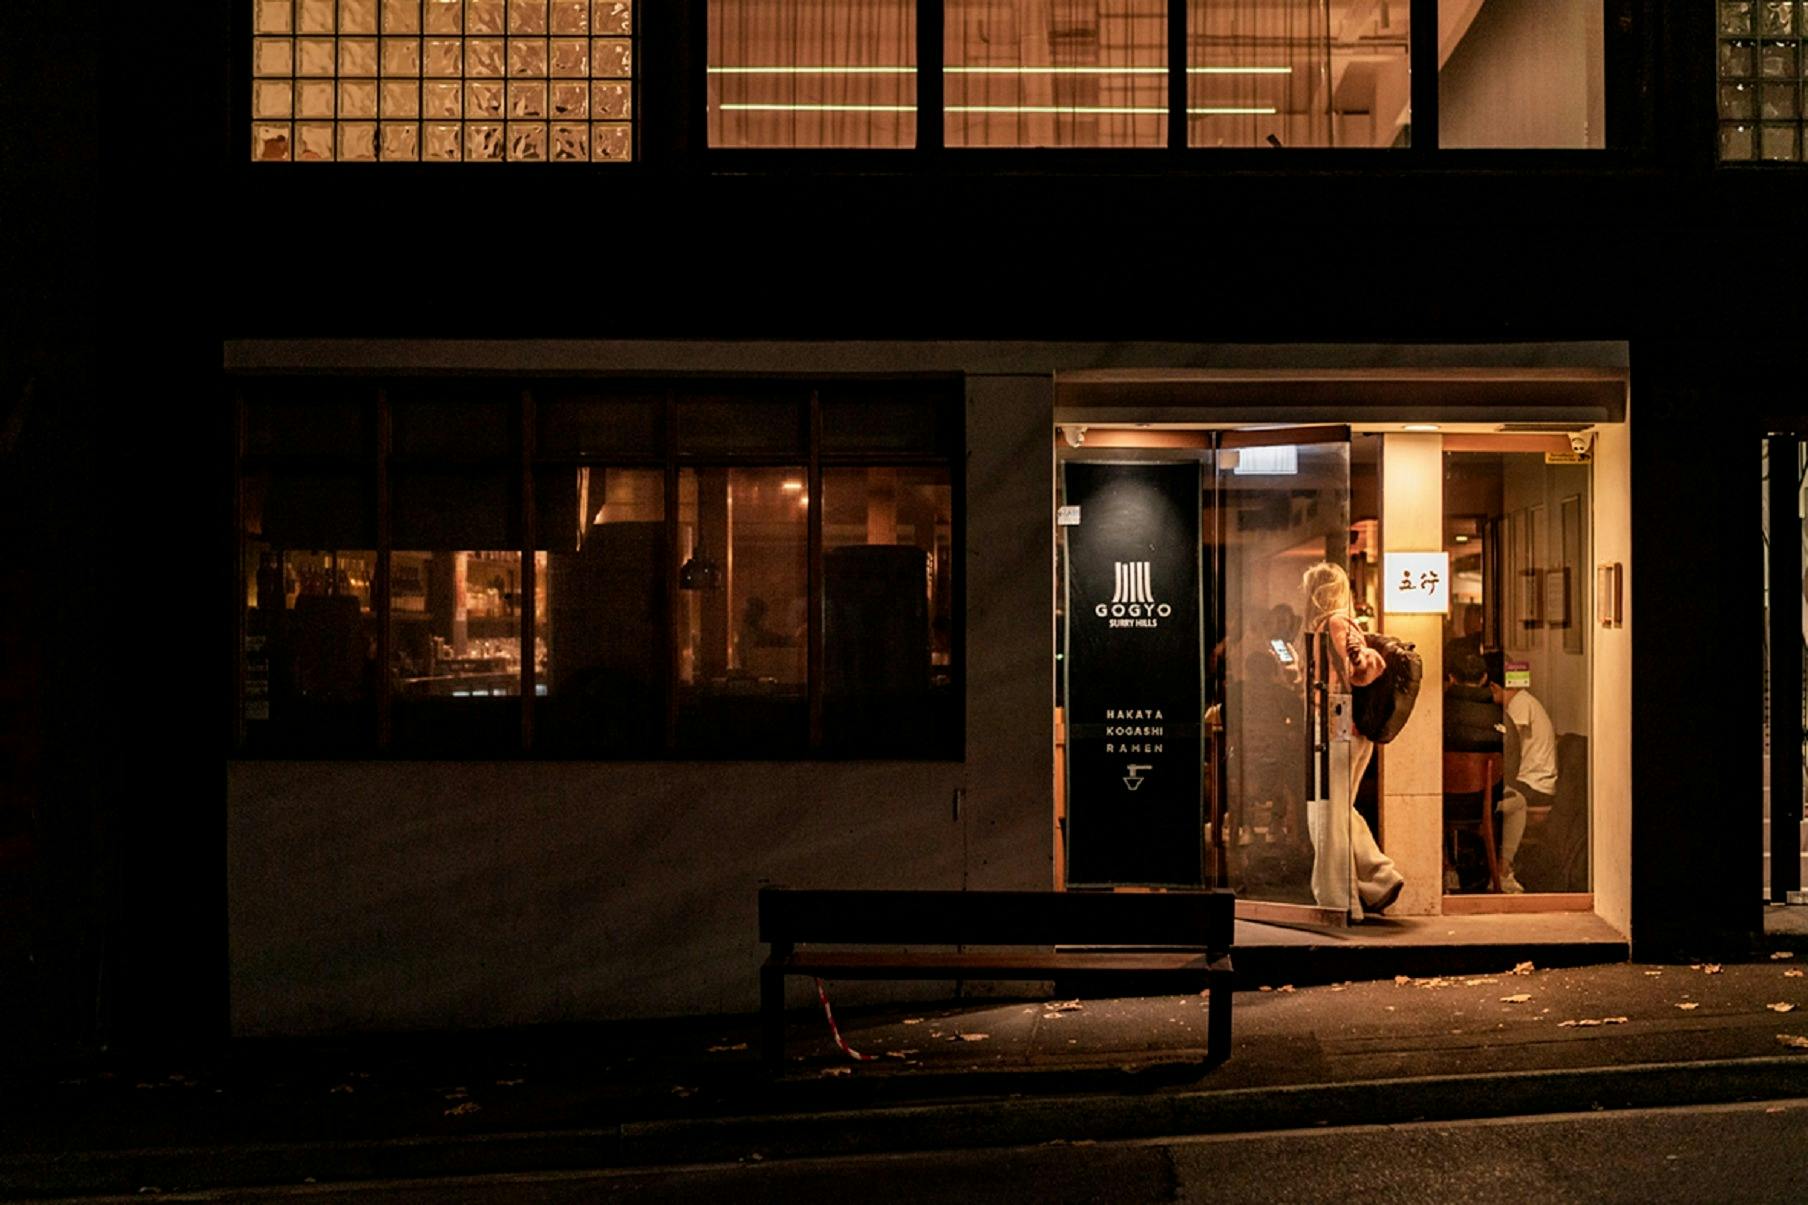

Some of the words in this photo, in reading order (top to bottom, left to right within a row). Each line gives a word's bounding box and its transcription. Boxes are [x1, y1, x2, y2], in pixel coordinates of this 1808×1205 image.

[1095, 603, 1171, 618] GOGYO
[1109, 618, 1134, 628] SURRY
[1135, 618, 1157, 628] HILLS
[1106, 709, 1163, 720] HAKATA
[1106, 726, 1164, 736] KOGASHI
[1106, 743, 1163, 753] RAMEN
